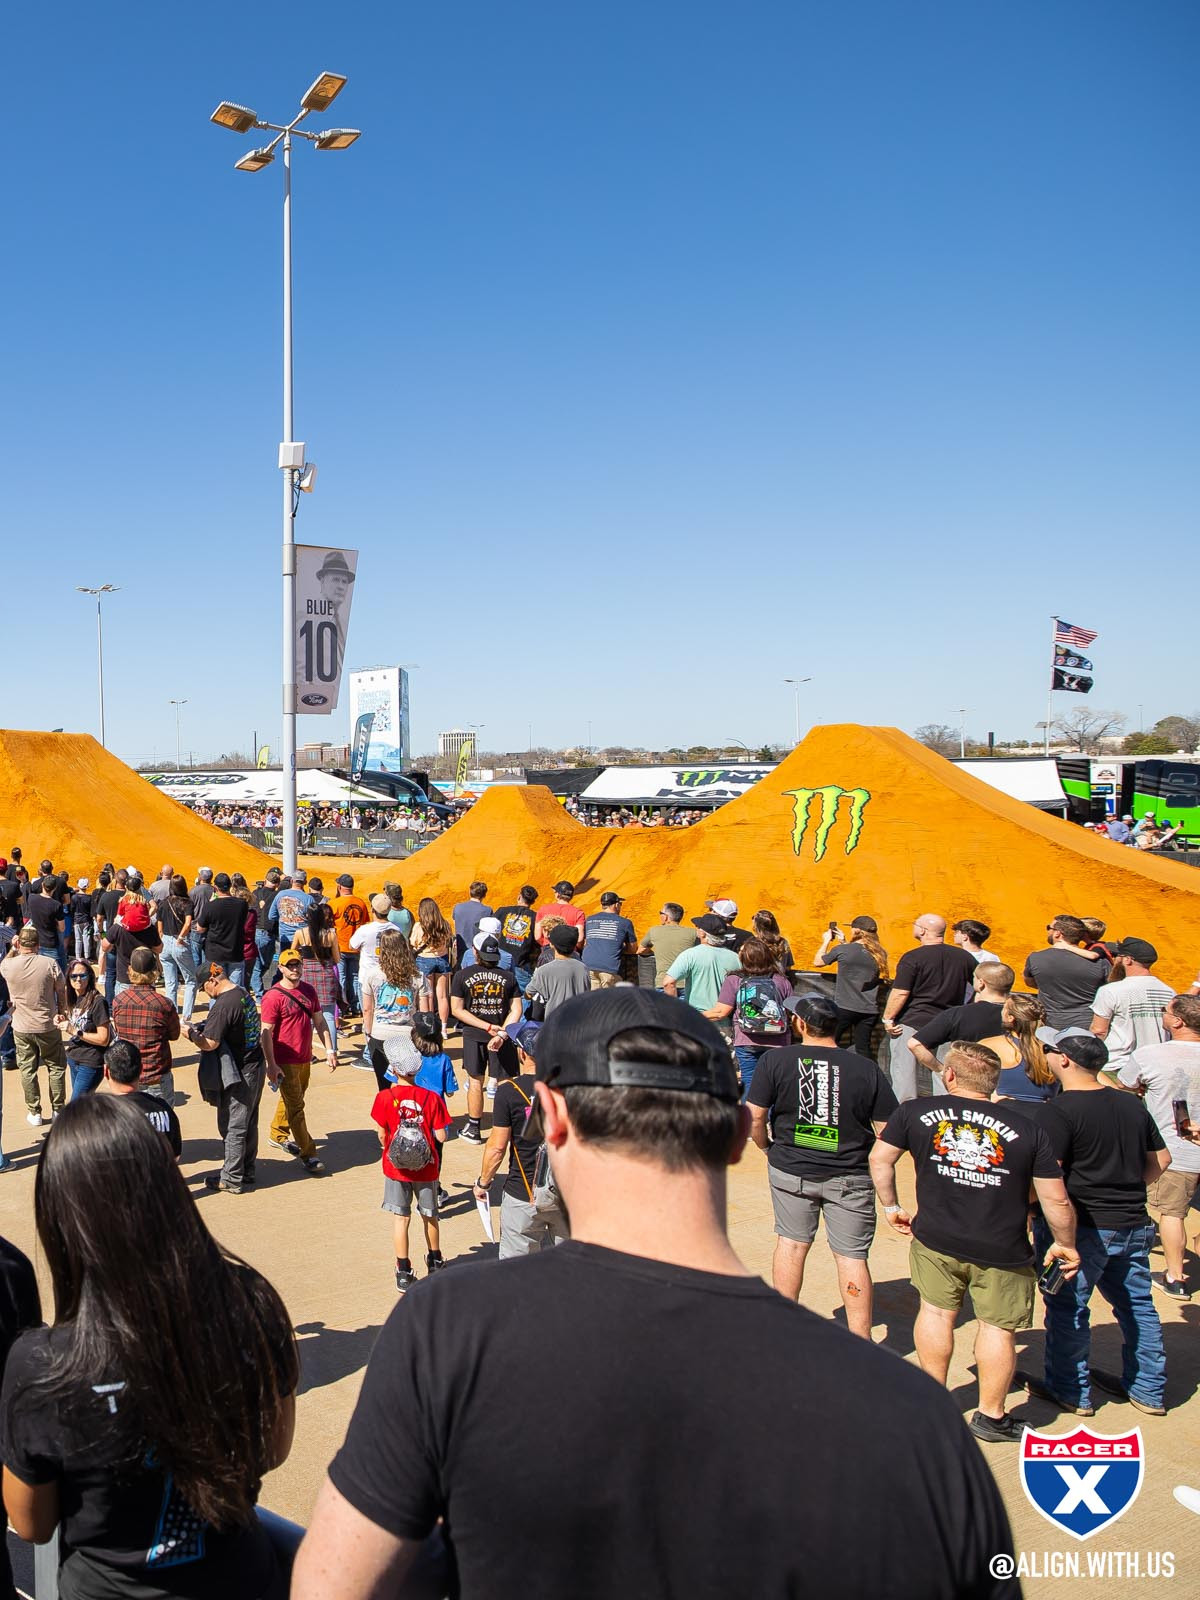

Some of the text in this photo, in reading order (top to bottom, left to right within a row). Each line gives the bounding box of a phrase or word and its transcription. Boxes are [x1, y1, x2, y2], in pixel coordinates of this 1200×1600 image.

[307, 599, 333, 616] BLUE
[300, 620, 338, 682] 10
[465, 972, 507, 988] FASTHOUSE
[832, 1065, 840, 1076] roll
[798, 1057, 815, 1125] KX
[832, 1076, 840, 1091] times
[814, 1060, 829, 1127] Kawasaki
[832, 1092, 841, 1107] good
[831, 1106, 839, 1116] the
[920, 1108, 1019, 1142] STILL SMOKIN
[937, 1164, 1002, 1186] FASTHOUSE
